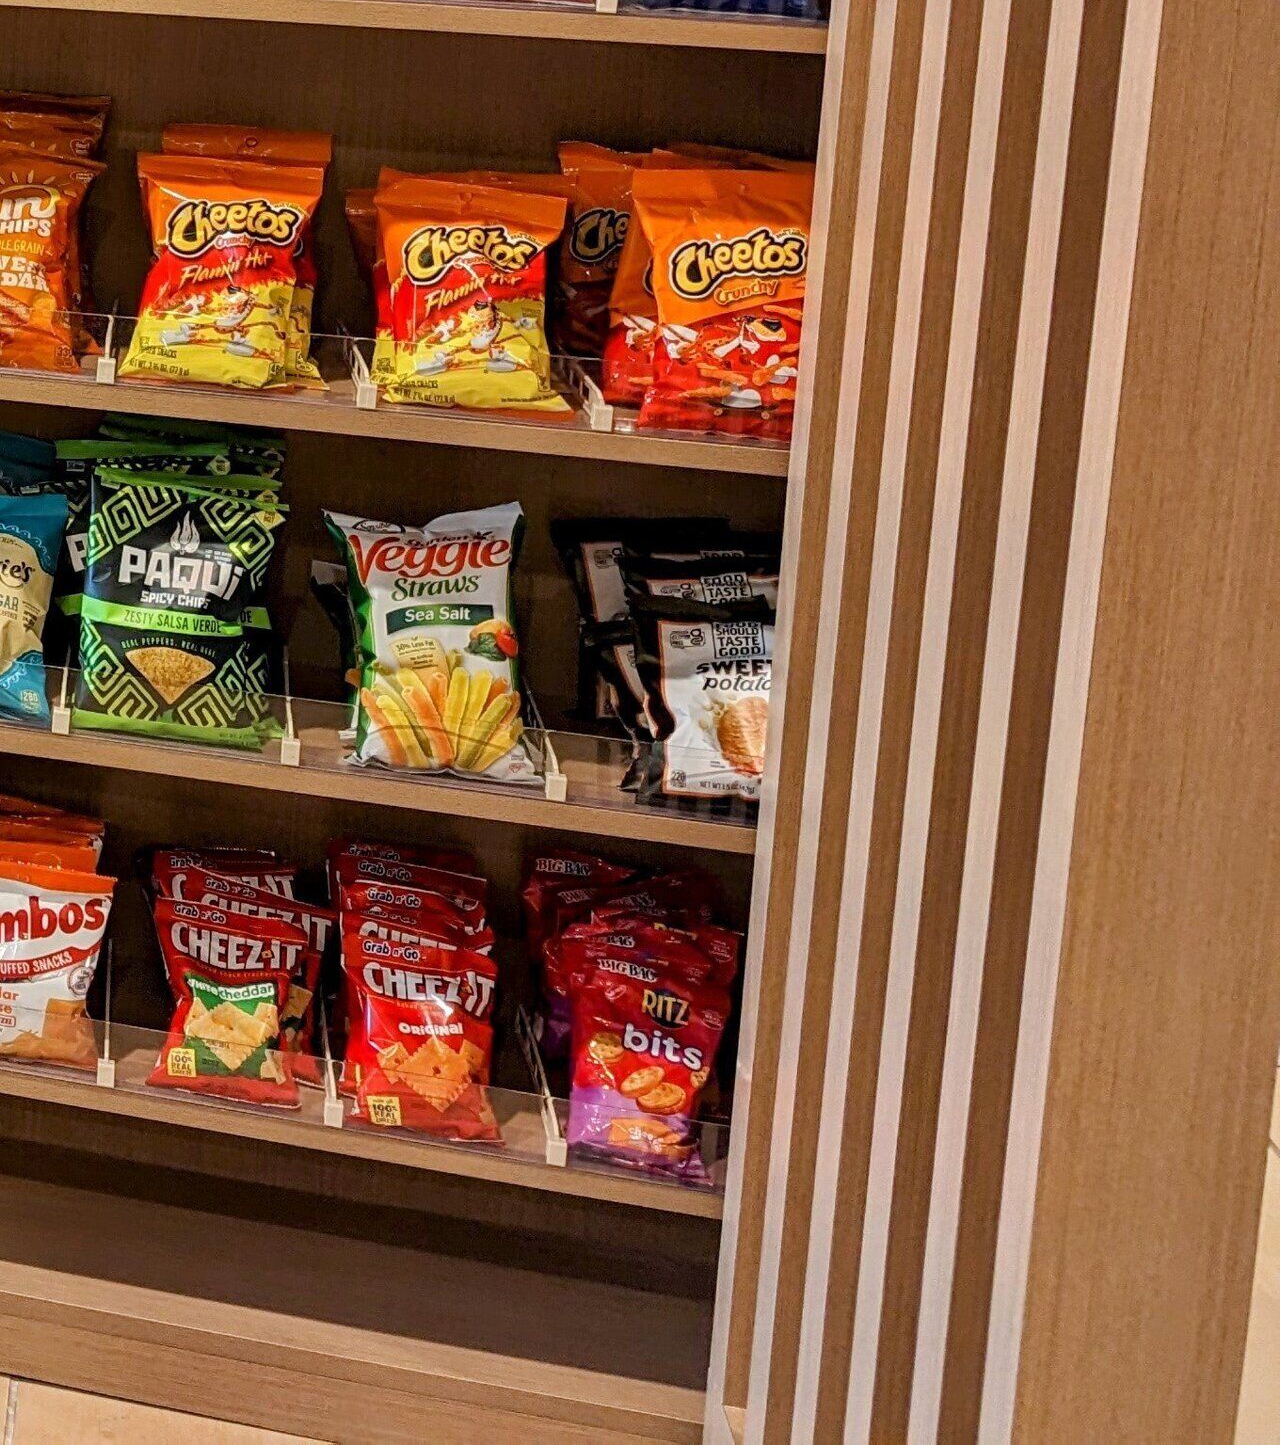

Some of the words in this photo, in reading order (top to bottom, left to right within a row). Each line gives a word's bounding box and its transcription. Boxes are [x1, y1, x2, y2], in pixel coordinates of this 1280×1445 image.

[168, 199, 300, 255] Cheetos
[14, 239, 46, 255] GRAIN
[405, 226, 539, 284] Cheetos
[671, 231, 805, 298] Cheetos
[713, 279, 779, 306] Crunchy
[348, 534, 513, 585] Veggie
[140, 590, 176, 607] SPICY
[177, 592, 210, 609] CHIPS
[391, 575, 480, 602] Straws
[123, 609, 155, 626] ZESTY
[157, 612, 189, 630] SALSA
[192, 616, 222, 634] VERDE
[404, 606, 437, 622] Sea
[439, 605, 472, 621] Salt
[716, 626, 761, 637] SHOULD
[718, 636, 760, 647] TASTE
[718, 646, 762, 657] GOOD
[37, 950, 73, 968] SNACKS
[170, 921, 303, 971] CHEEZ-IT
[219, 984, 275, 1000] cheddar
[643, 989, 690, 1026] RITZ
[623, 1023, 703, 1071] bits
